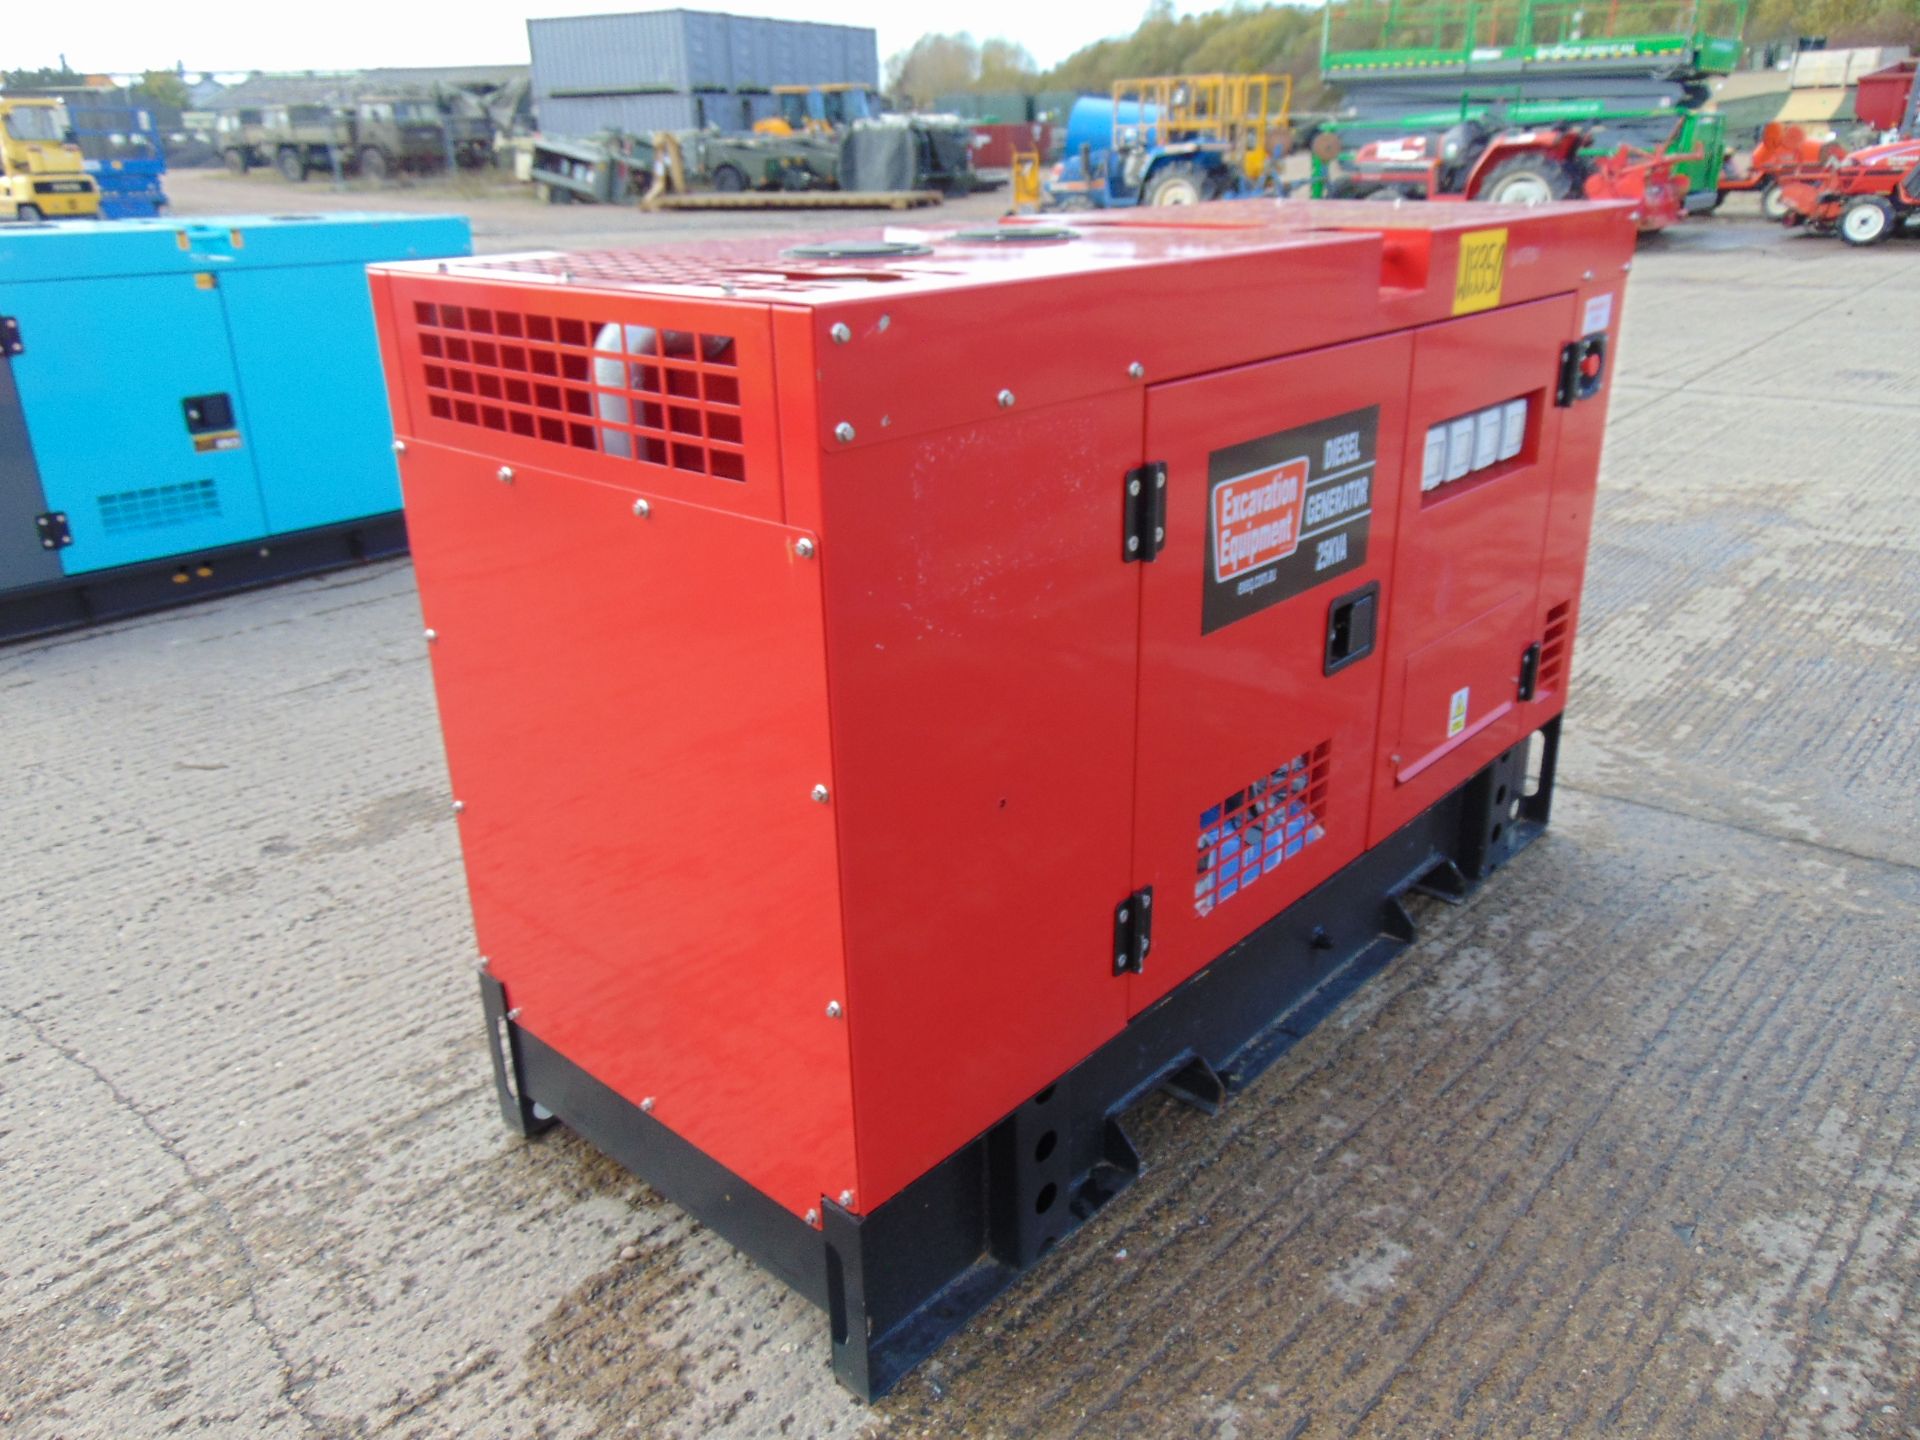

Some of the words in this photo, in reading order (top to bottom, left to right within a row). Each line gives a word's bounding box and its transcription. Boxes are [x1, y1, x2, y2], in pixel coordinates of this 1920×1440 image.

[1322, 431, 1361, 470] DIESEL
[1221, 471, 1299, 526] Excavation
[1306, 476, 1369, 526] GENERATOR
[1220, 508, 1294, 570] Equipment
